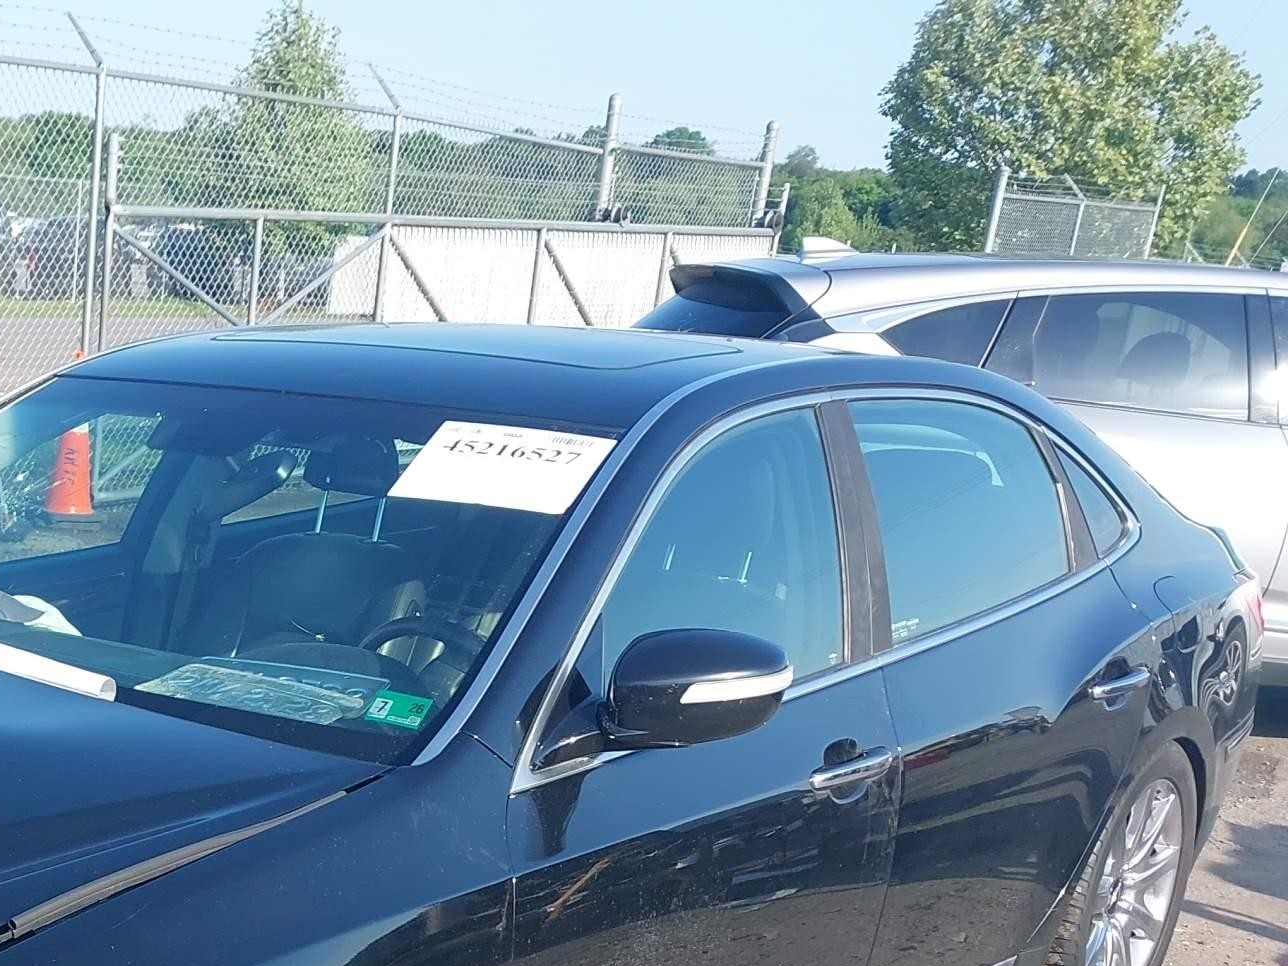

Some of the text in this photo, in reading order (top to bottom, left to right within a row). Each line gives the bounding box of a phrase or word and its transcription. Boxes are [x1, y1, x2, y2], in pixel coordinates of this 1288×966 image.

[443, 439, 582, 465] 45216527
[376, 700, 426, 715] 7 26
